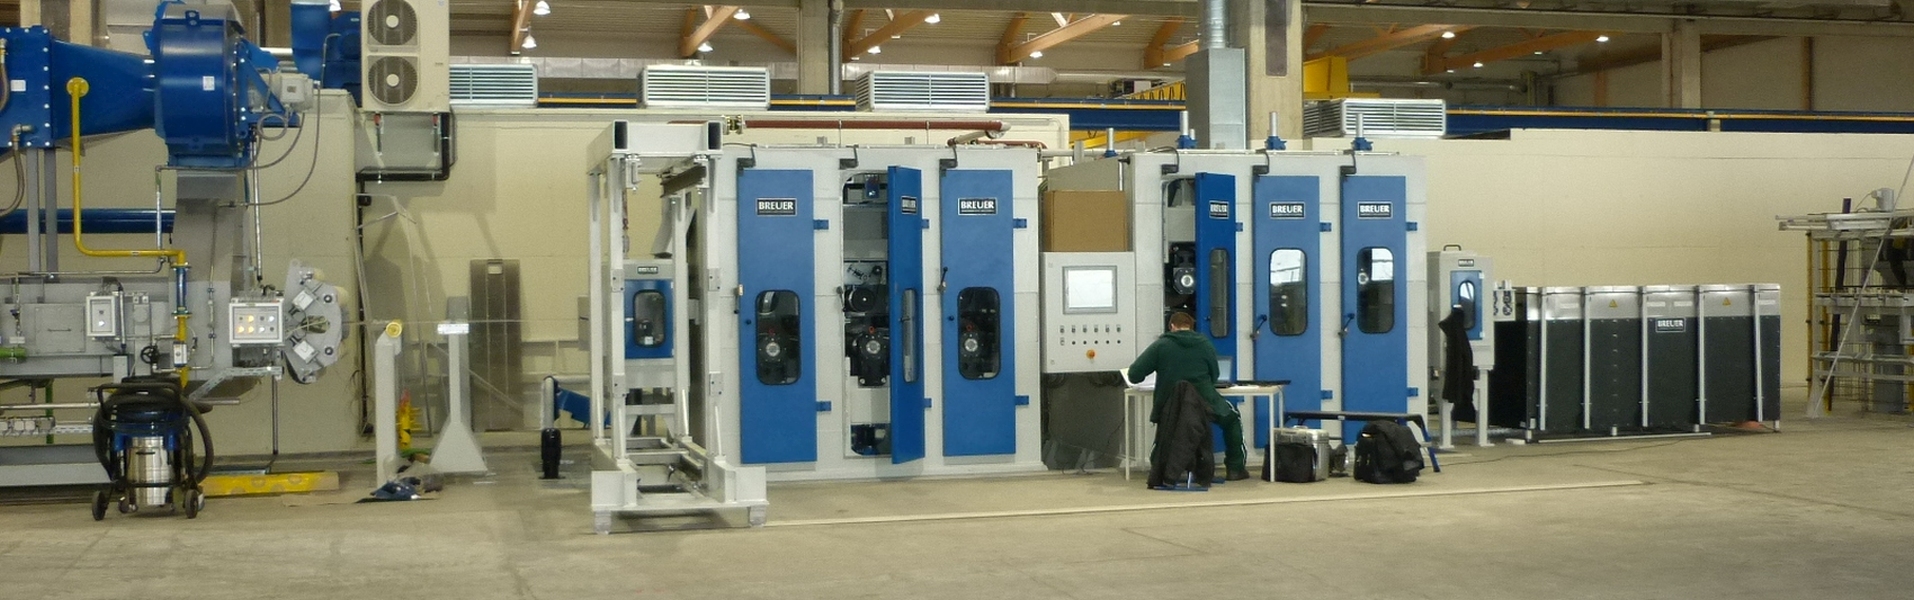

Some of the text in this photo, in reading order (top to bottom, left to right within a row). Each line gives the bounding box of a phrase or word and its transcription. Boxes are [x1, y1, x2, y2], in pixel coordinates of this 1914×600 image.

[759, 201, 794, 210] BREUER
[960, 200, 995, 209] BREUER
[1272, 205, 1303, 213] BREUER
[1359, 204, 1390, 213] BREUER
